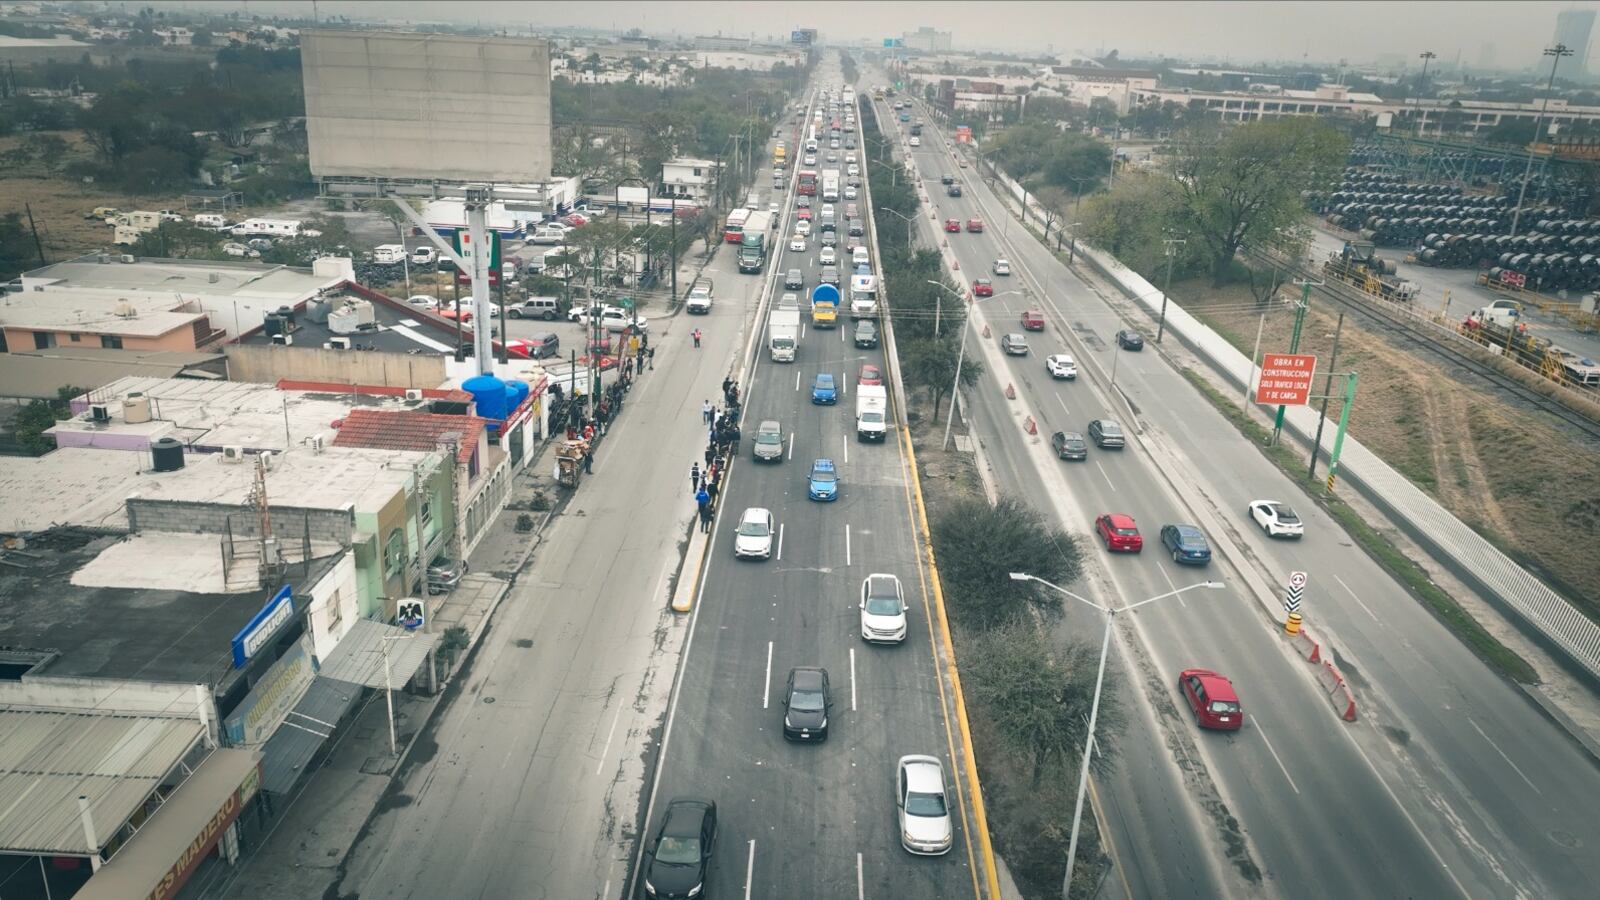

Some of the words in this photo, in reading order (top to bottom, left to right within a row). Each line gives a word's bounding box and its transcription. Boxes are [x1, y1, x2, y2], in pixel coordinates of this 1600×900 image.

[1273, 358, 1292, 366] OBRA
[1294, 359, 1305, 367] EN
[1262, 369, 1310, 378] CONSTRUCCION
[1261, 380, 1273, 388] SOLO
[1274, 381, 1293, 389] TRAFICO
[1293, 382, 1308, 390] LOCAL
[1265, 391, 1270, 399] Y
[1271, 391, 1279, 399] DE
[1280, 392, 1297, 400] CARGA
[249, 626, 268, 653] BUD
[267, 602, 290, 632] LIGHT
[145, 871, 176, 900] ES
